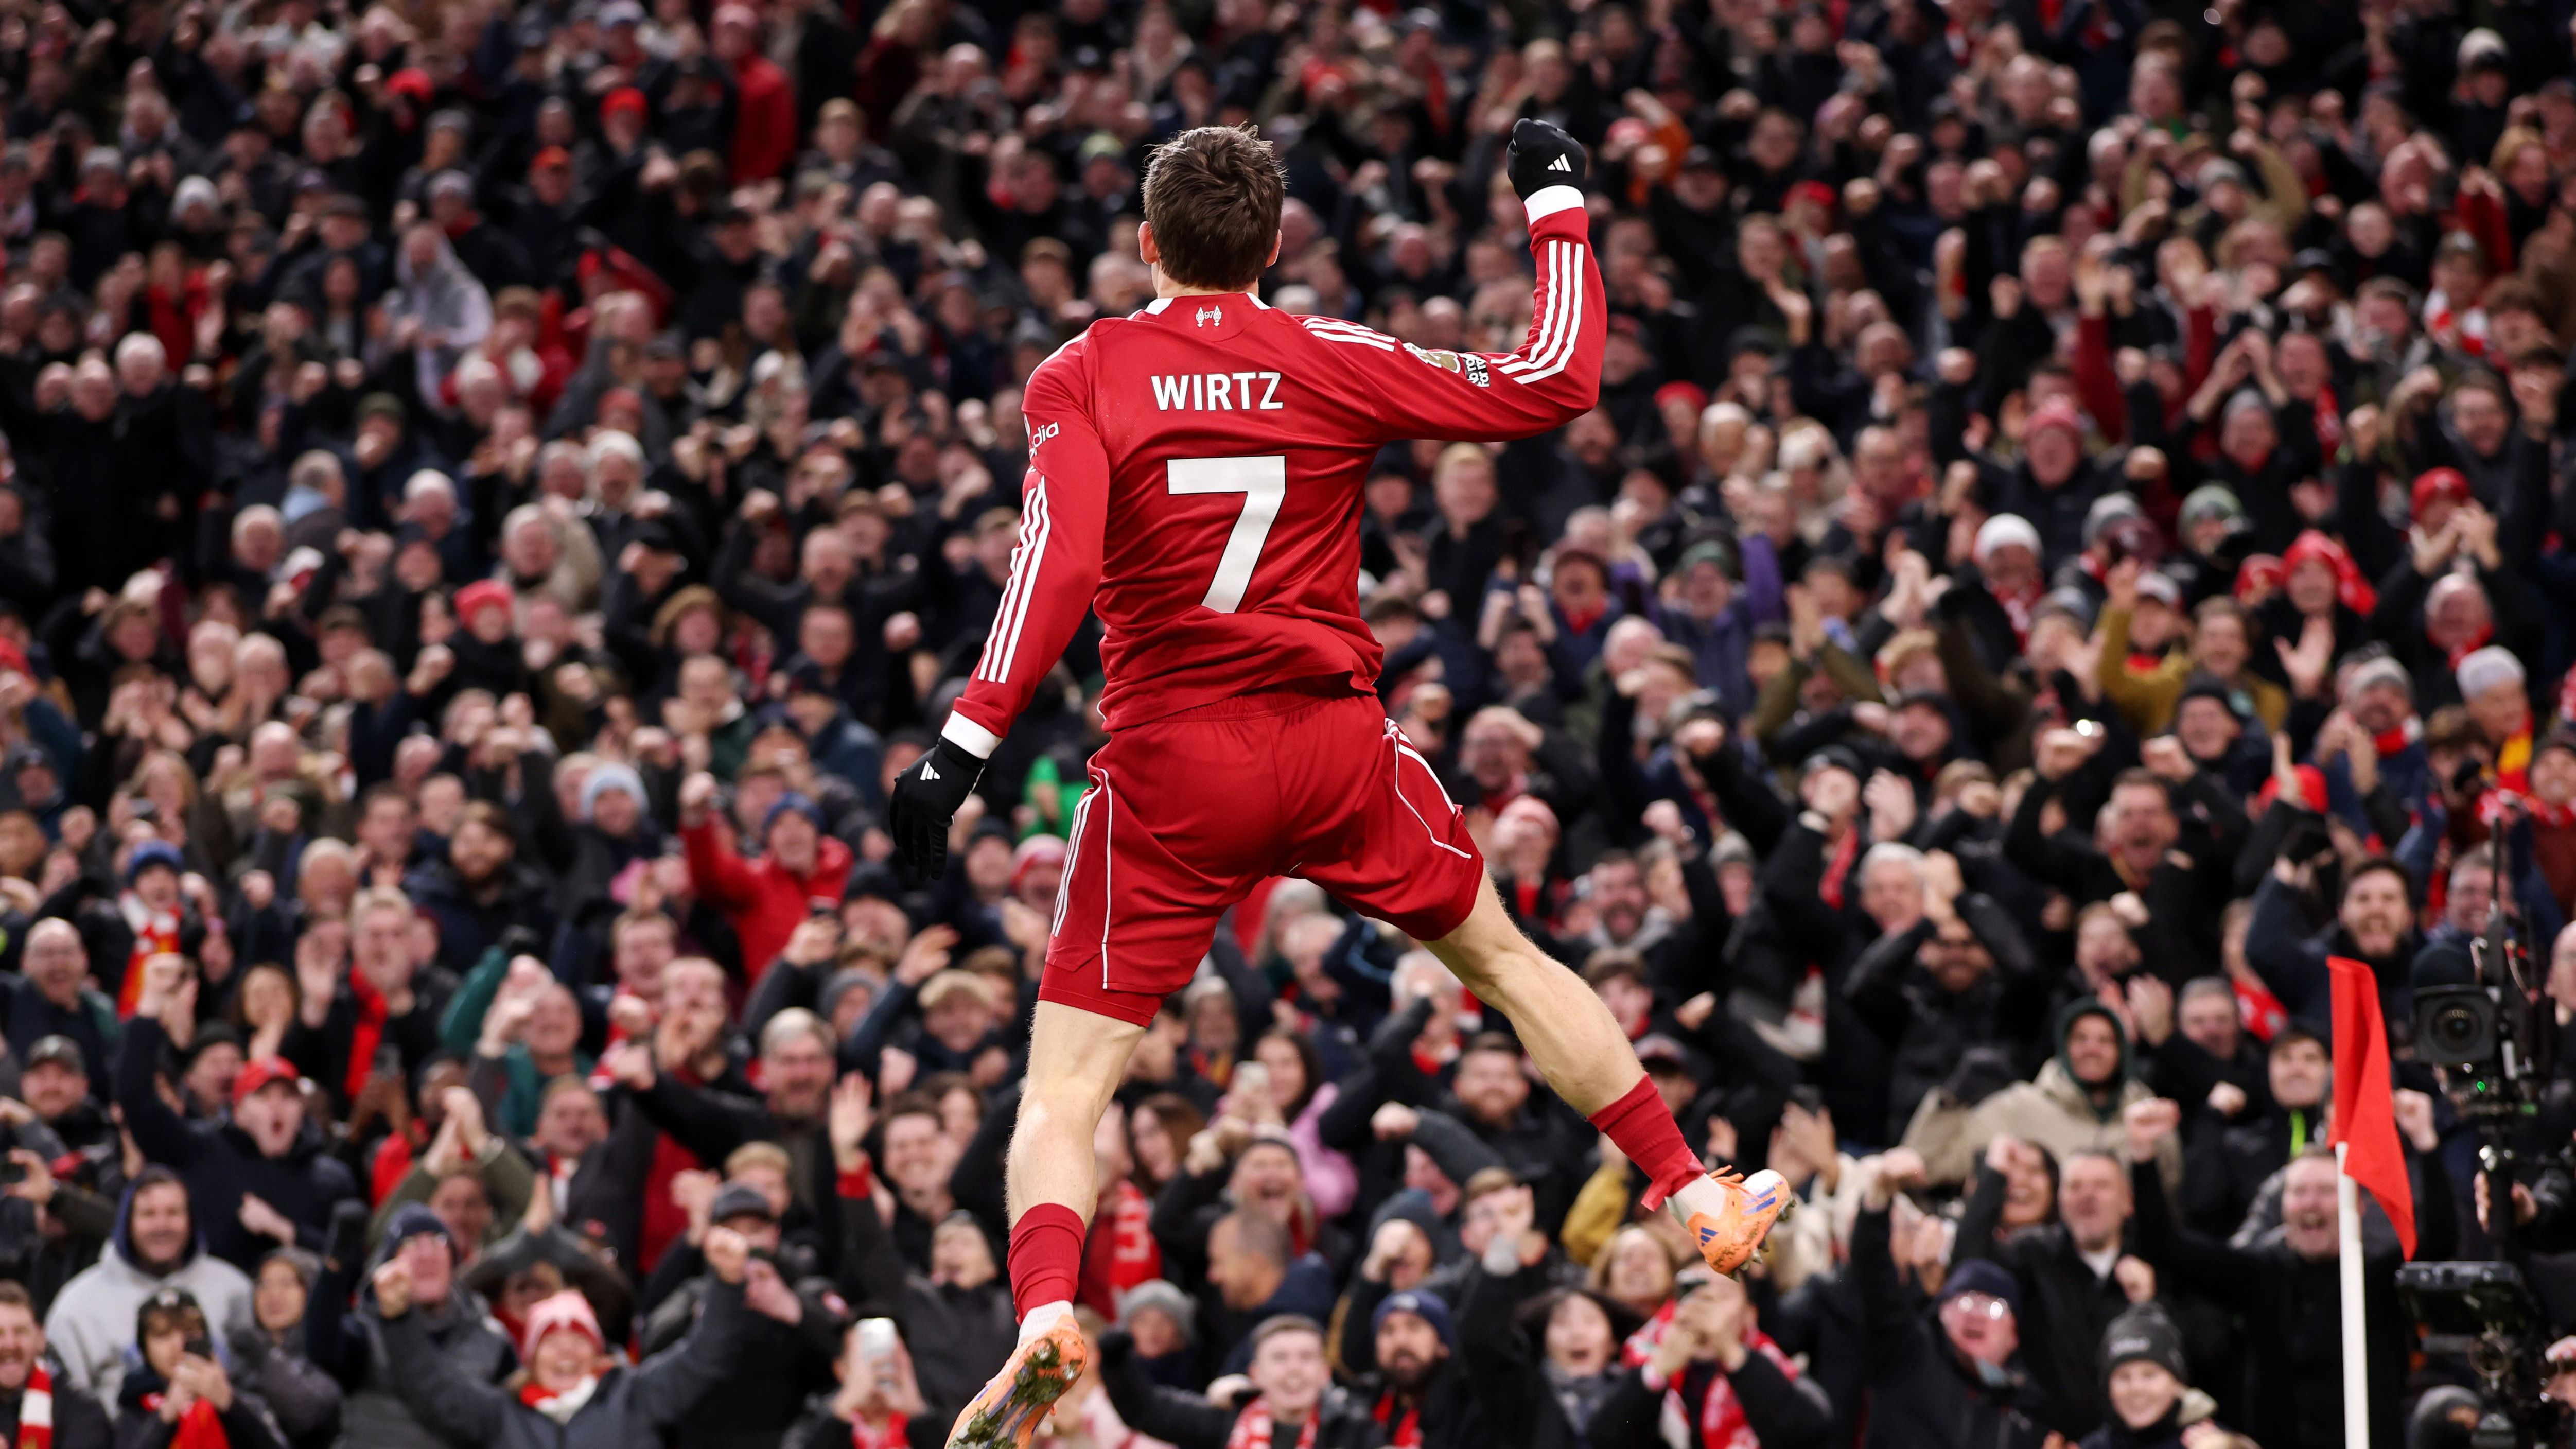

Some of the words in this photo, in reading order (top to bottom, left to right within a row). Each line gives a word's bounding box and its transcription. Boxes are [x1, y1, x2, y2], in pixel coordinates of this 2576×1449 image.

[1204, 311, 1214, 319] 97
[1151, 372, 1284, 411] WIRTZ
[1477, 371, 1490, 387] for
[1167, 455, 1286, 614] 7
